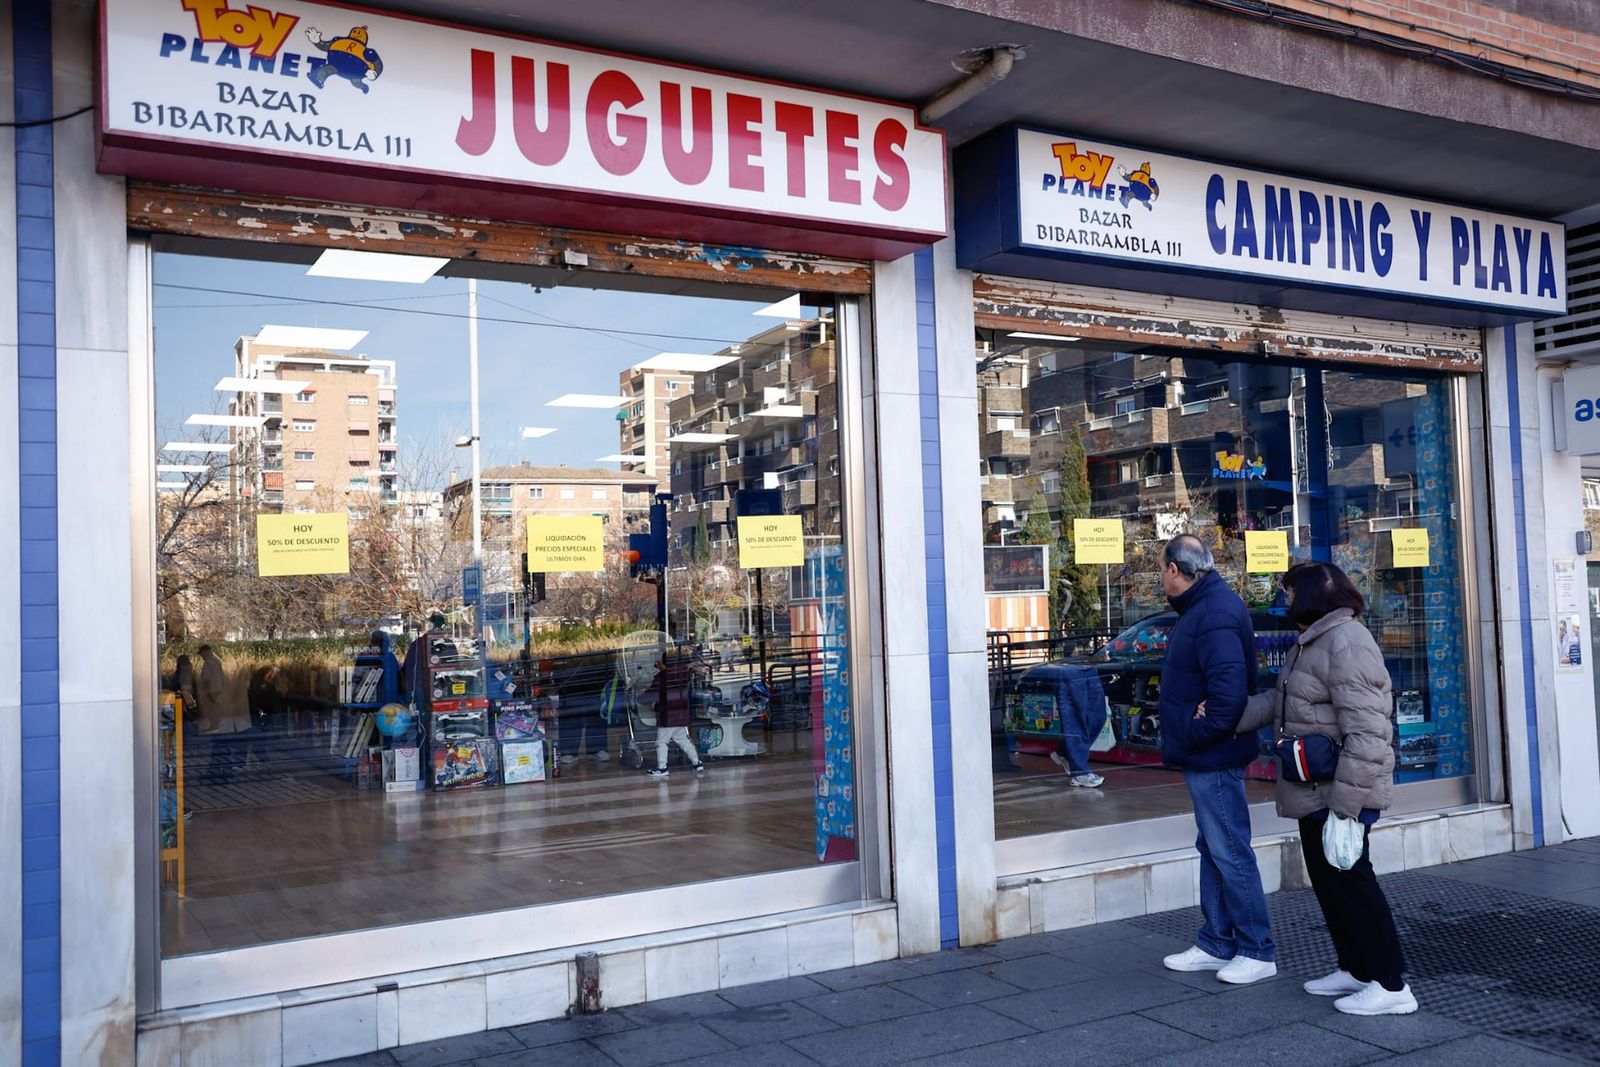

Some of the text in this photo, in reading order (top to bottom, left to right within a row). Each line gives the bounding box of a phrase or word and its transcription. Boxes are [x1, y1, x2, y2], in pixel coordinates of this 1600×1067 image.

[181, 0, 301, 58] TOY
[159, 32, 328, 80] PLANET
[216, 81, 319, 116] BAZAR
[132, 101, 374, 153] BIBARRAMBLA
[454, 48, 911, 212] JUGUETES
[1051, 142, 1115, 188] TOY
[1042, 173, 1130, 202] PLANET
[1078, 207, 1132, 229] BAZAR
[1037, 224, 1161, 256] BIBARRAMBLA
[1206, 174, 1557, 299] CAMPING Y PLAYA
[1215, 450, 1245, 473] TOY
[267, 538, 283, 546] 50%
[293, 525, 313, 533] HOY
[545, 534, 586, 542] LIQUIDACIÓN
